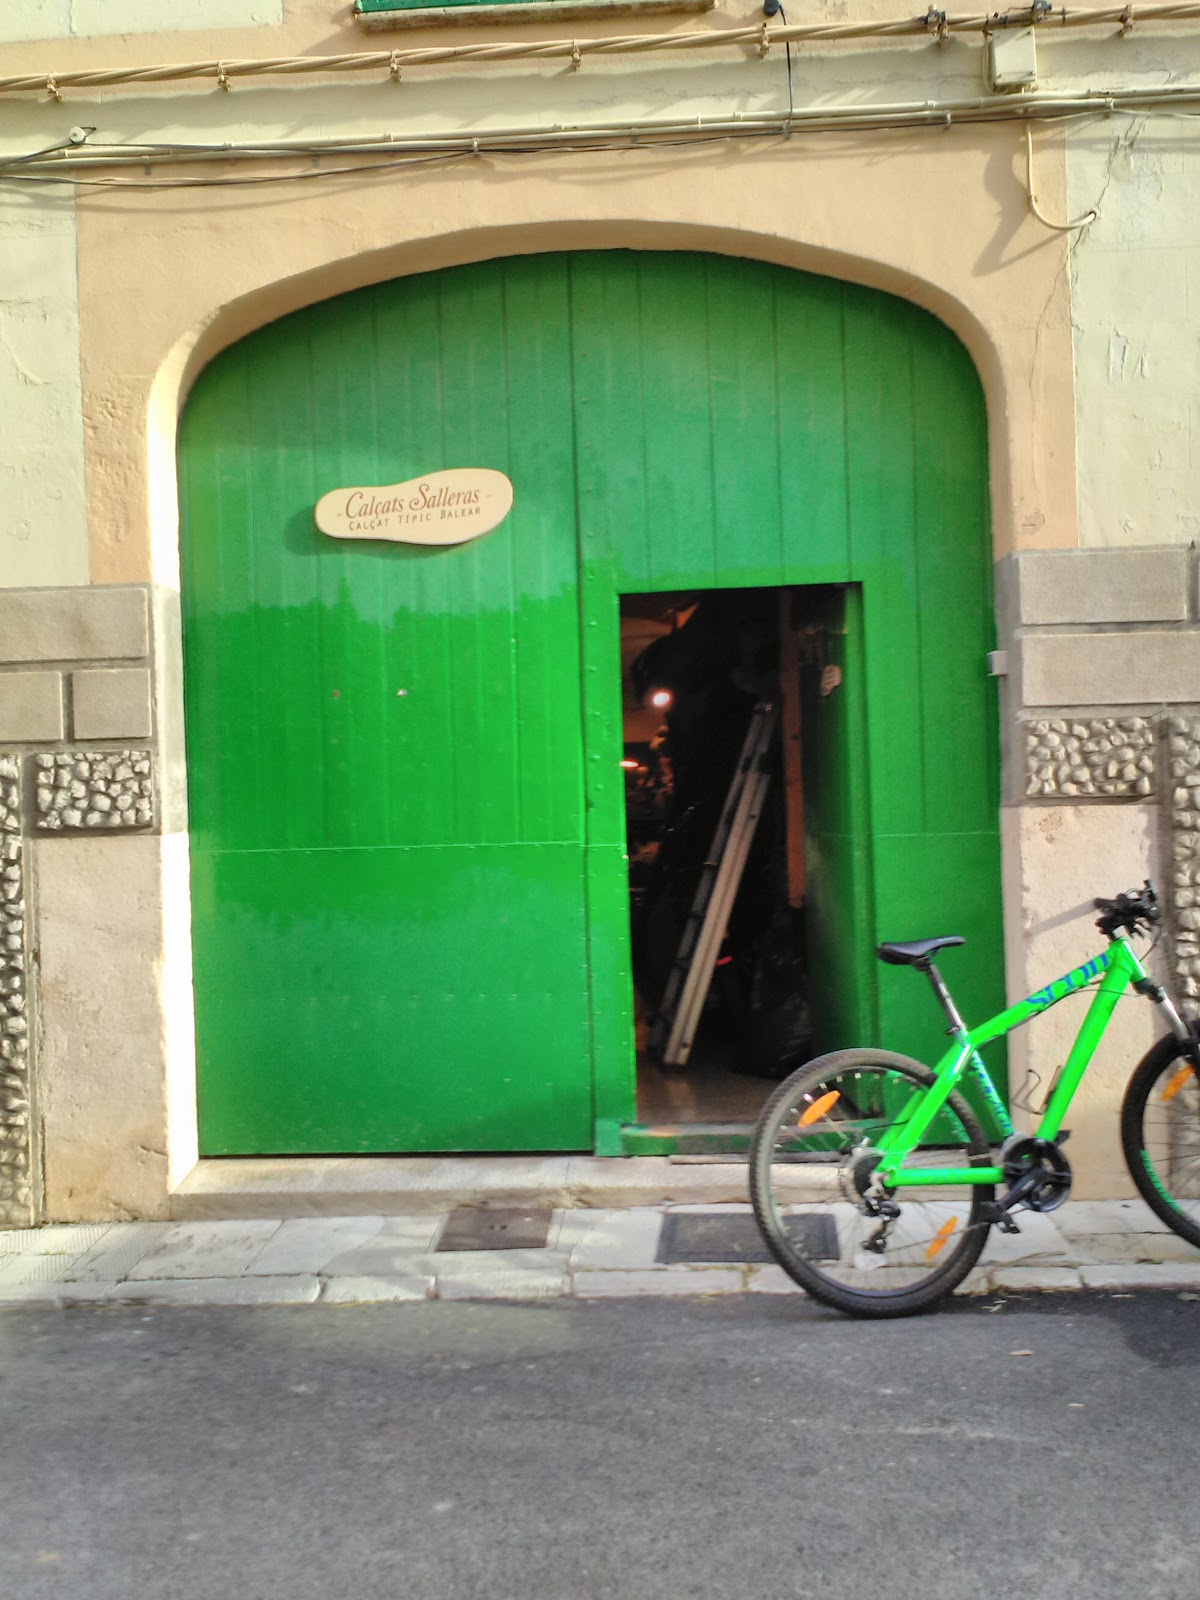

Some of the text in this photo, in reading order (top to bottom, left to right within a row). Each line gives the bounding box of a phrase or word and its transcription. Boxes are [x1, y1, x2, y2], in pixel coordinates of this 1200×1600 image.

[345, 484, 480, 519] Calçats Salleras
[349, 518, 389, 531] CALÇAT
[440, 507, 481, 520] BALEAR
